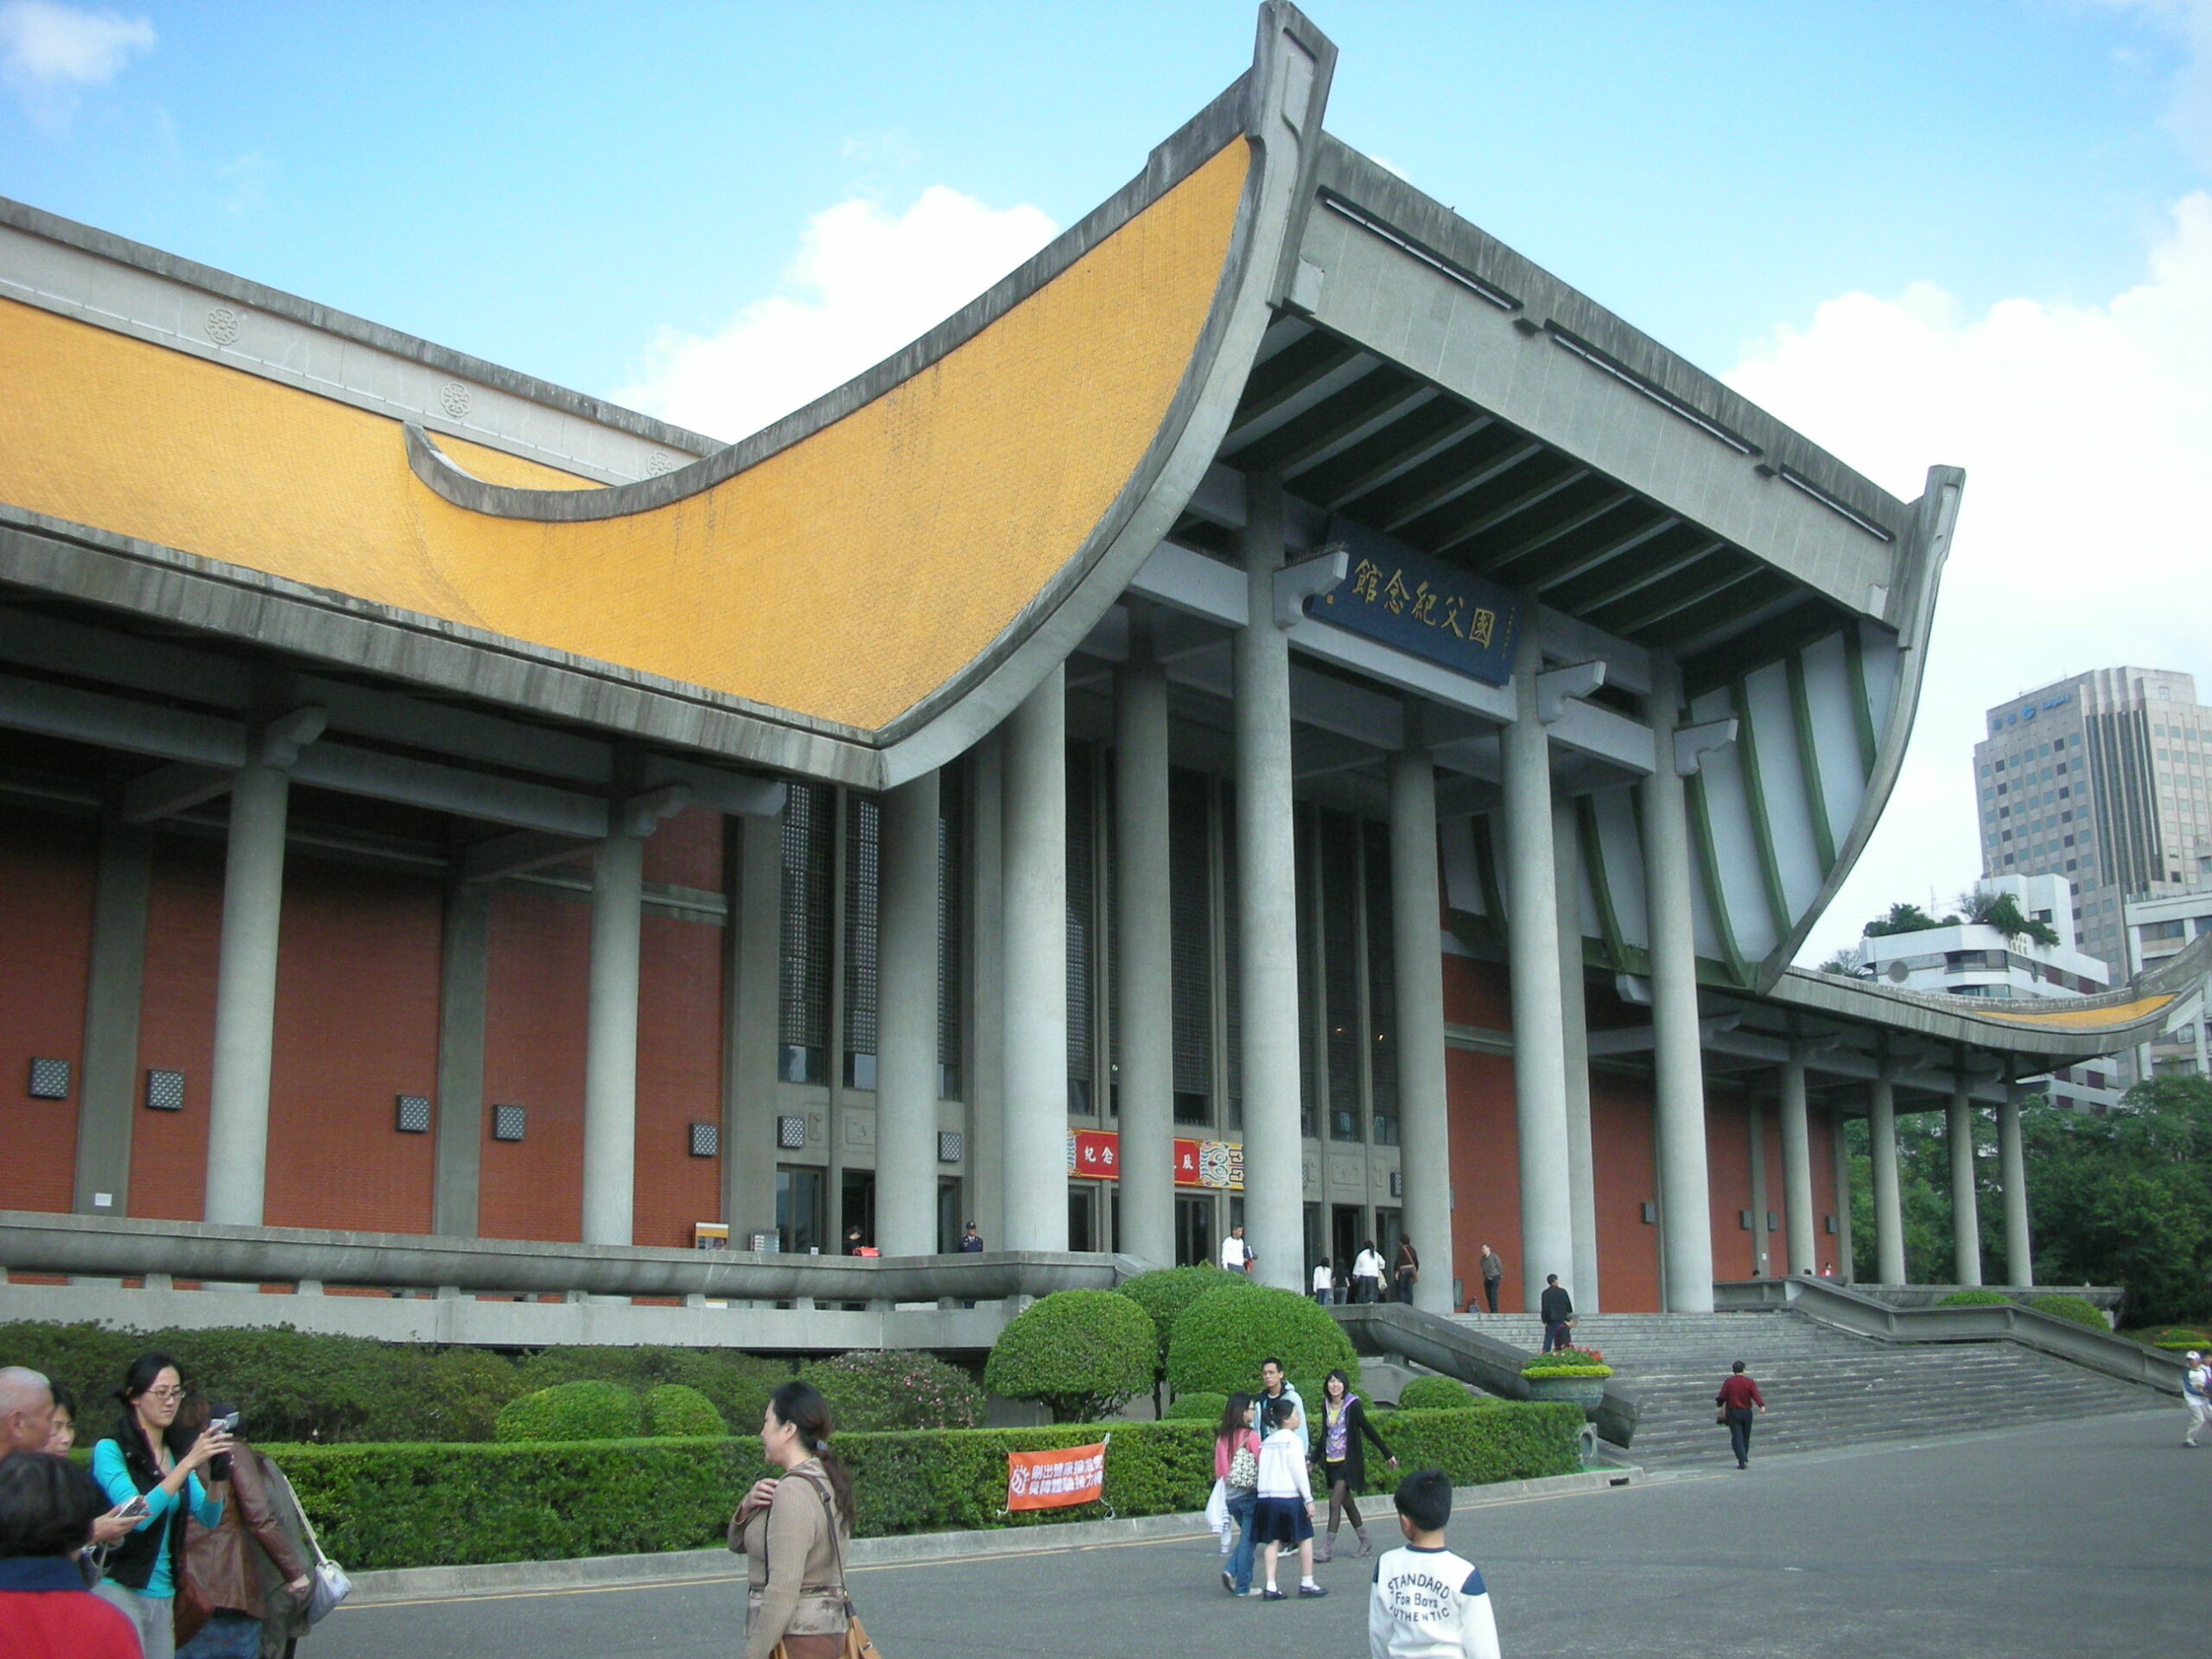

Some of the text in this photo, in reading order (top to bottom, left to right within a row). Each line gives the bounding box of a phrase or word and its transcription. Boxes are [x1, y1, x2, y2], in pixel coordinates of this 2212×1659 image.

[1351, 558, 1496, 649] 國父紀念館
[1084, 1145, 1115, 1166] 紀念
[1388, 1573, 1450, 1599] STANDARD
